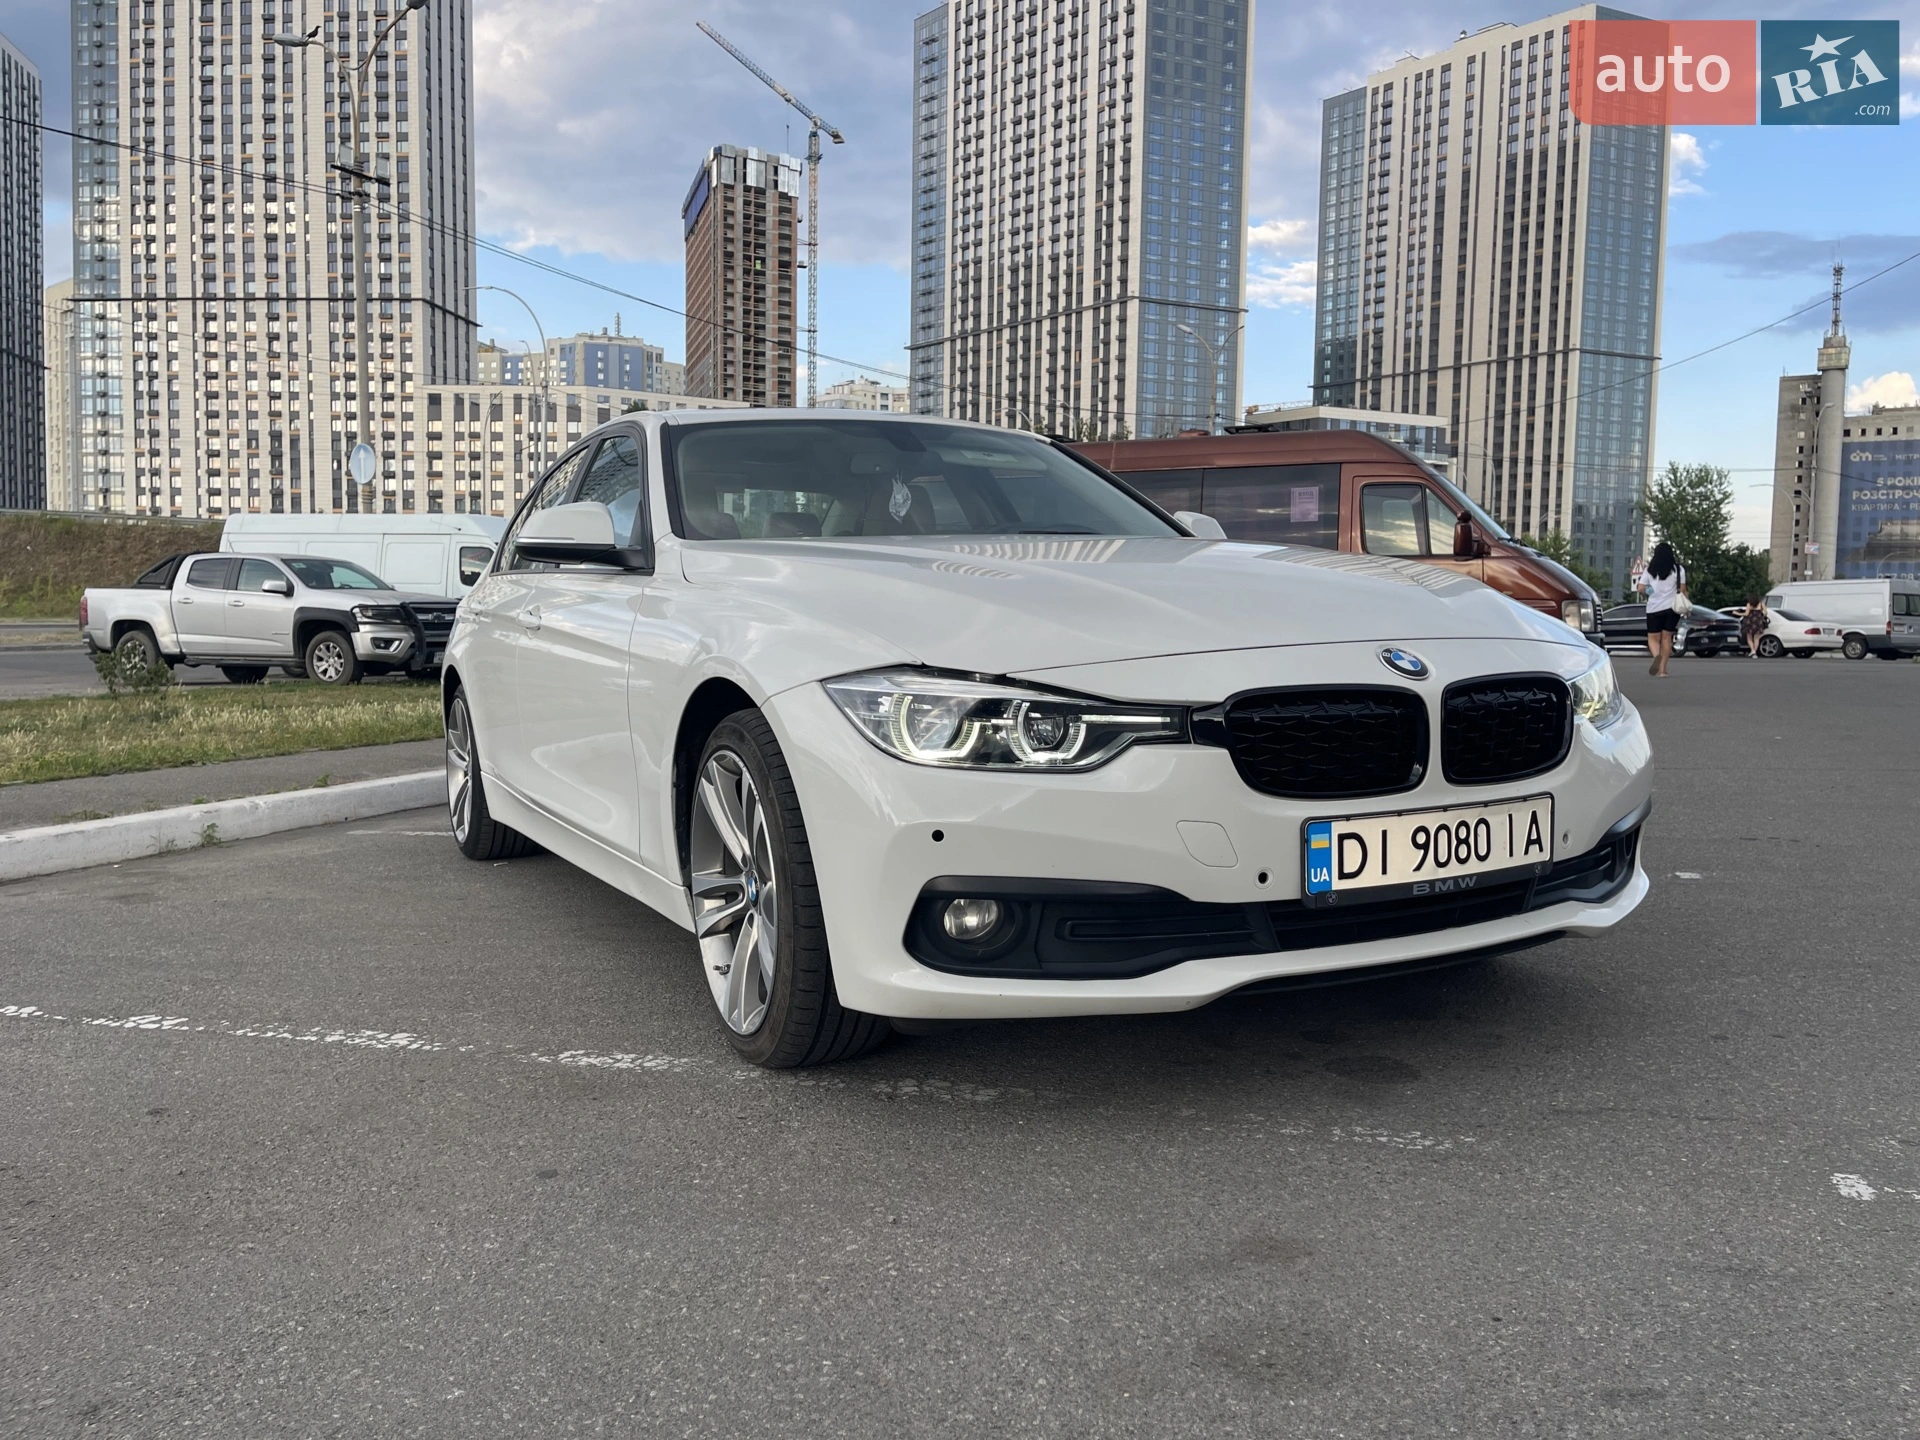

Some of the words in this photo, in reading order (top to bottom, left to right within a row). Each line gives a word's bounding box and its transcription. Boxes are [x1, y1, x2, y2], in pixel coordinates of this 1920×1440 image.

[1876, 477, 1884, 487] 5
[1887, 477, 1920, 486] РОКІ
[1851, 503, 1900, 511] КВАРТИРА
[1337, 829, 1388, 880] DI
[1410, 817, 1491, 872] 9080
[1507, 810, 1544, 858] IA
[1311, 867, 1330, 883] UA
[1412, 875, 1478, 895] BMW
